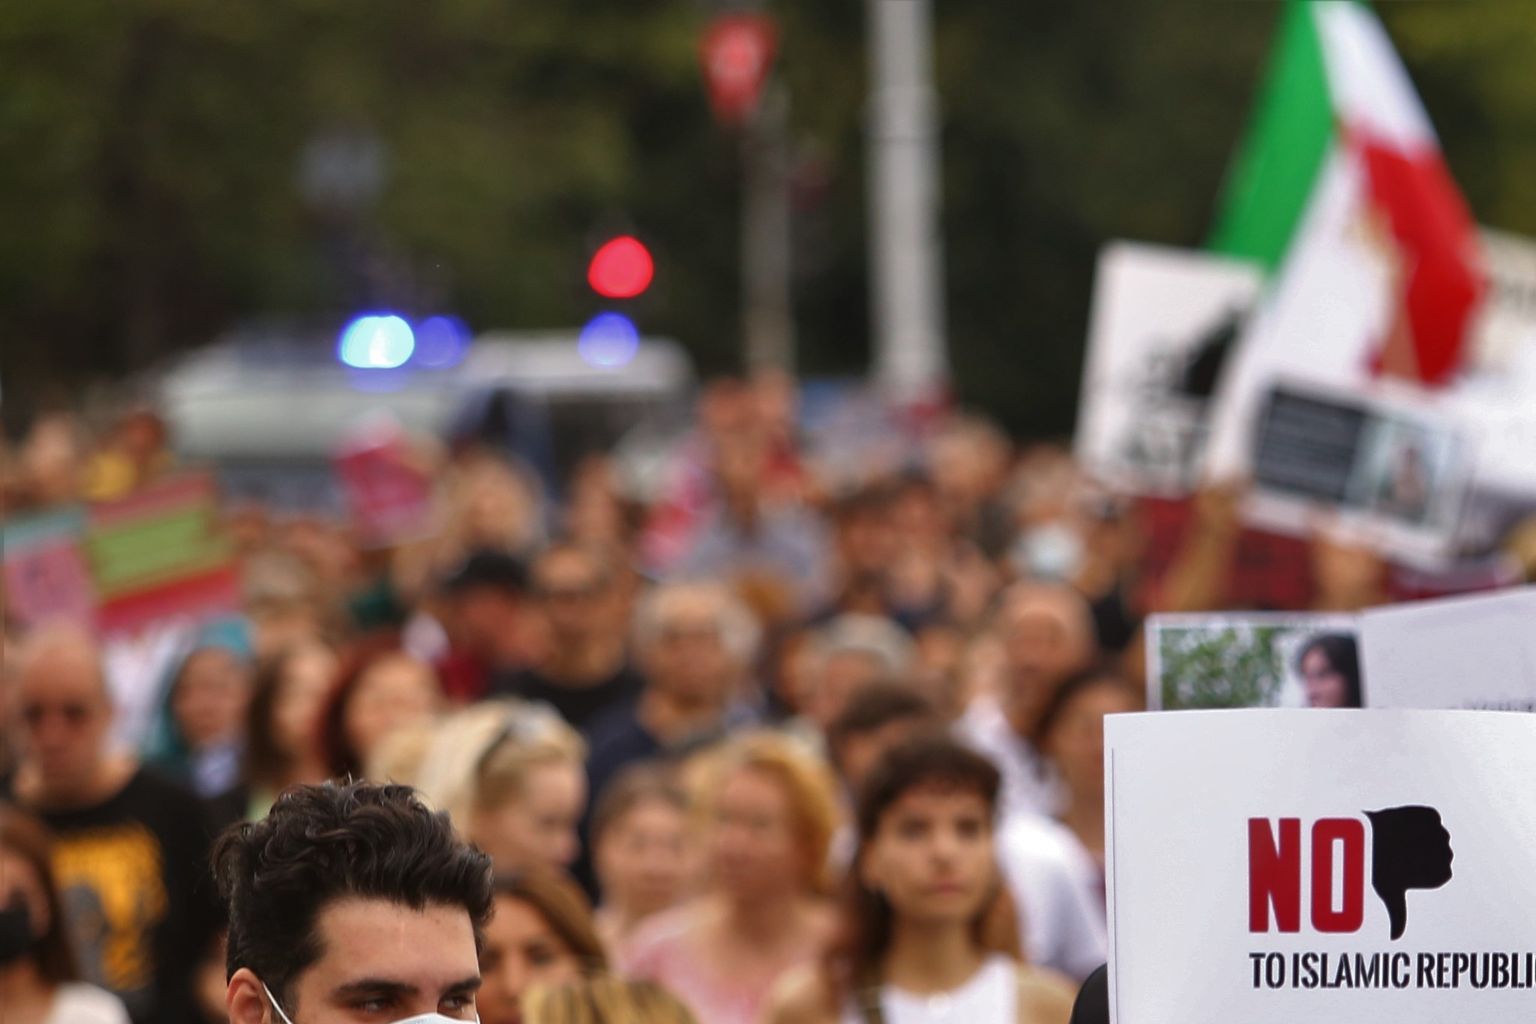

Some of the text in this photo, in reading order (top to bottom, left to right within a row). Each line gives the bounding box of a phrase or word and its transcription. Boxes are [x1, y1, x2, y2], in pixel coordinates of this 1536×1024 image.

[1249, 817, 1365, 933] NO
[1249, 952, 1286, 989] TO
[1292, 952, 1411, 989] ISLAMIC
